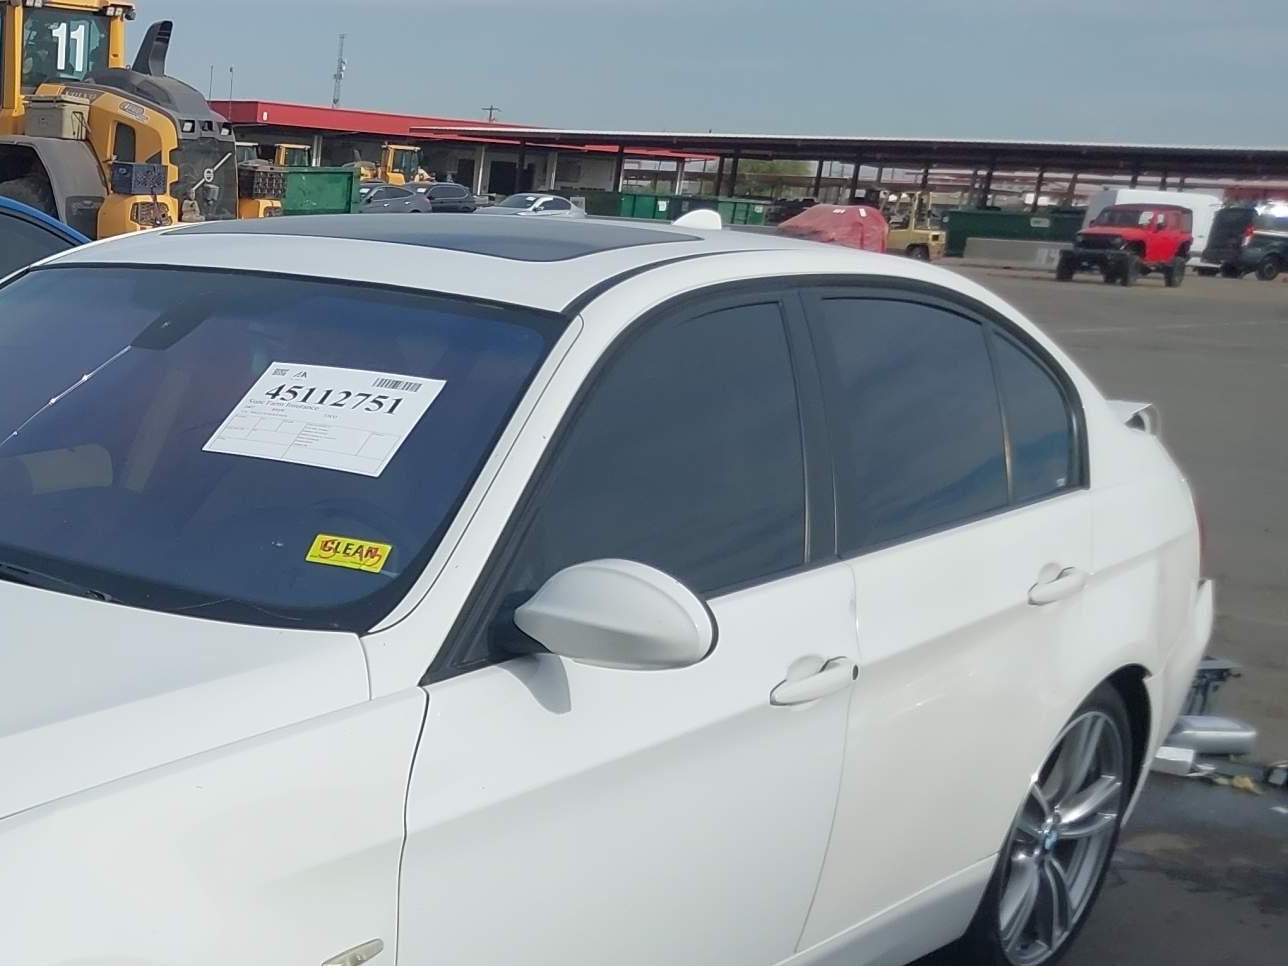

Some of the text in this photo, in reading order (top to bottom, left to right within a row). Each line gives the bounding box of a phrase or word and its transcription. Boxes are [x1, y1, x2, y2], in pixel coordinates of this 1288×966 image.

[52, 22, 85, 72] 11
[264, 383, 404, 415] 45112751
[320, 539, 380, 559] CLEAN
